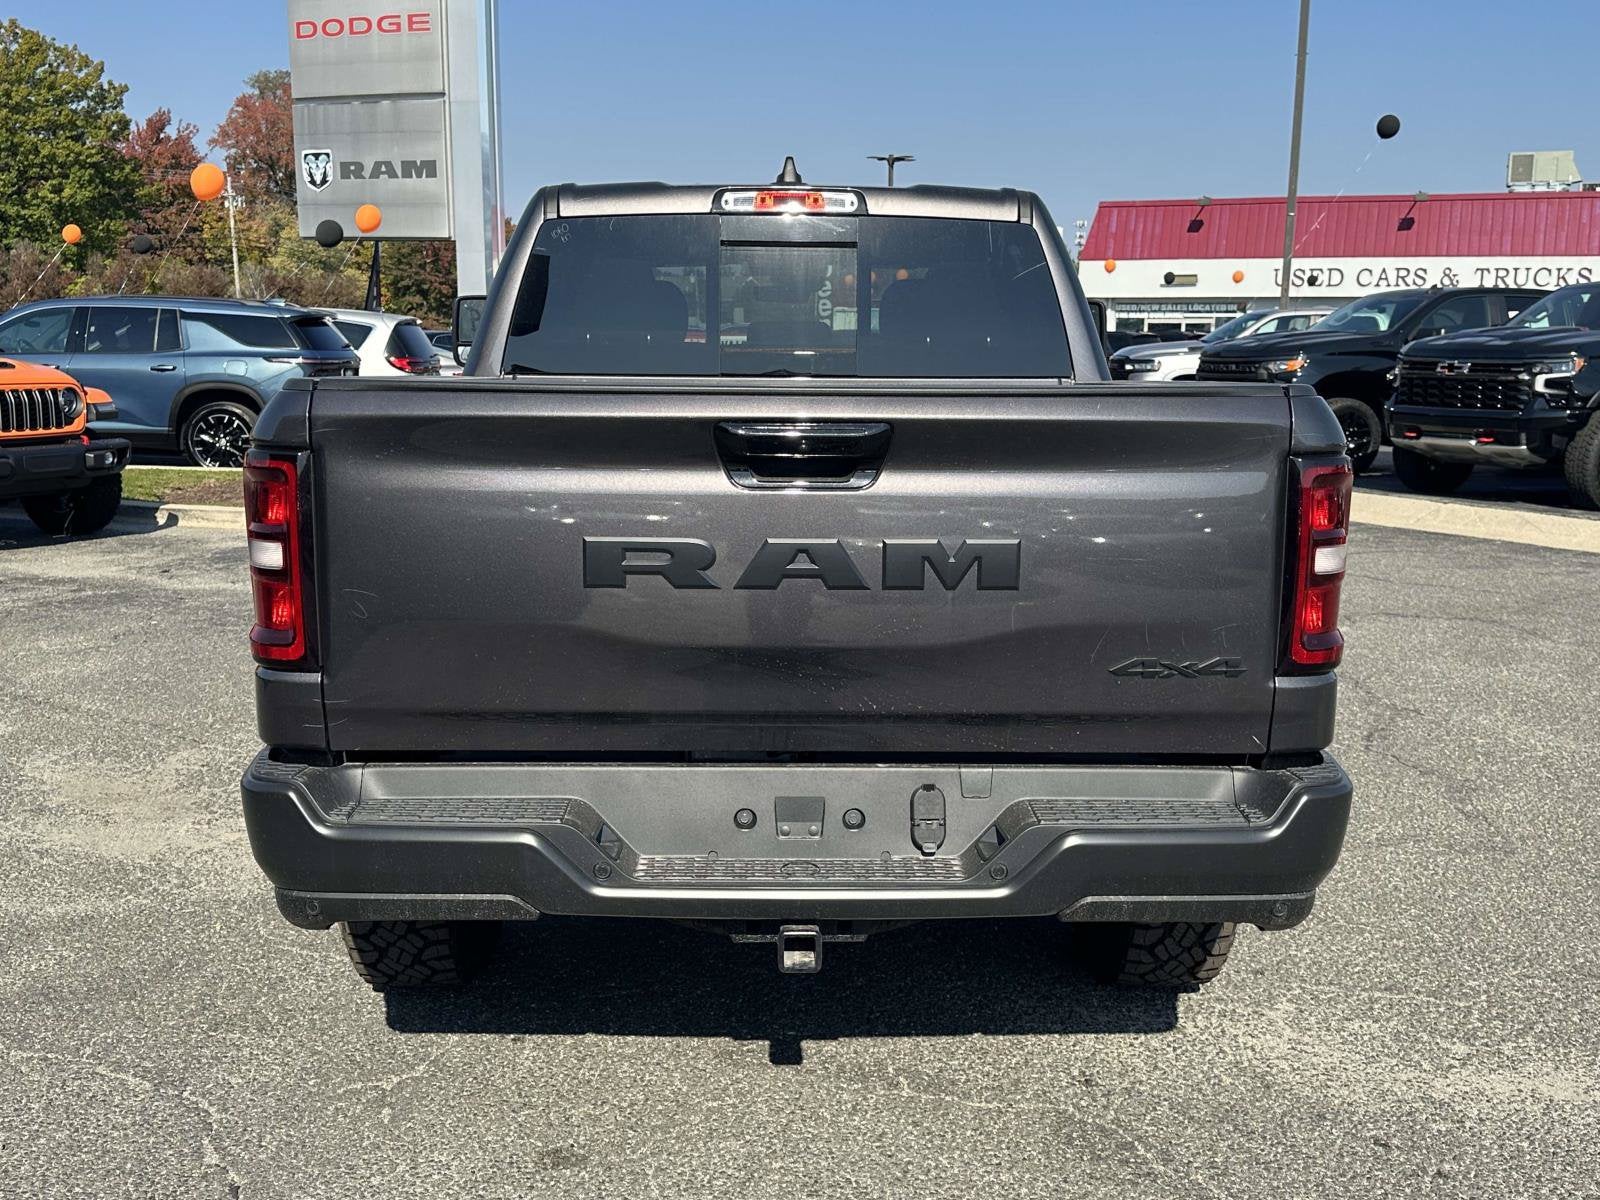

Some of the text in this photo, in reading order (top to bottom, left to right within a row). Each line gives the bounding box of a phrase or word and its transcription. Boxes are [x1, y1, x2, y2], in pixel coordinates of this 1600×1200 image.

[295, 12, 432, 40] DODGE
[339, 159, 438, 180] RAM
[1273, 267, 1593, 288] USED CARS & TRUCKS
[582, 536, 1022, 590] RAM
